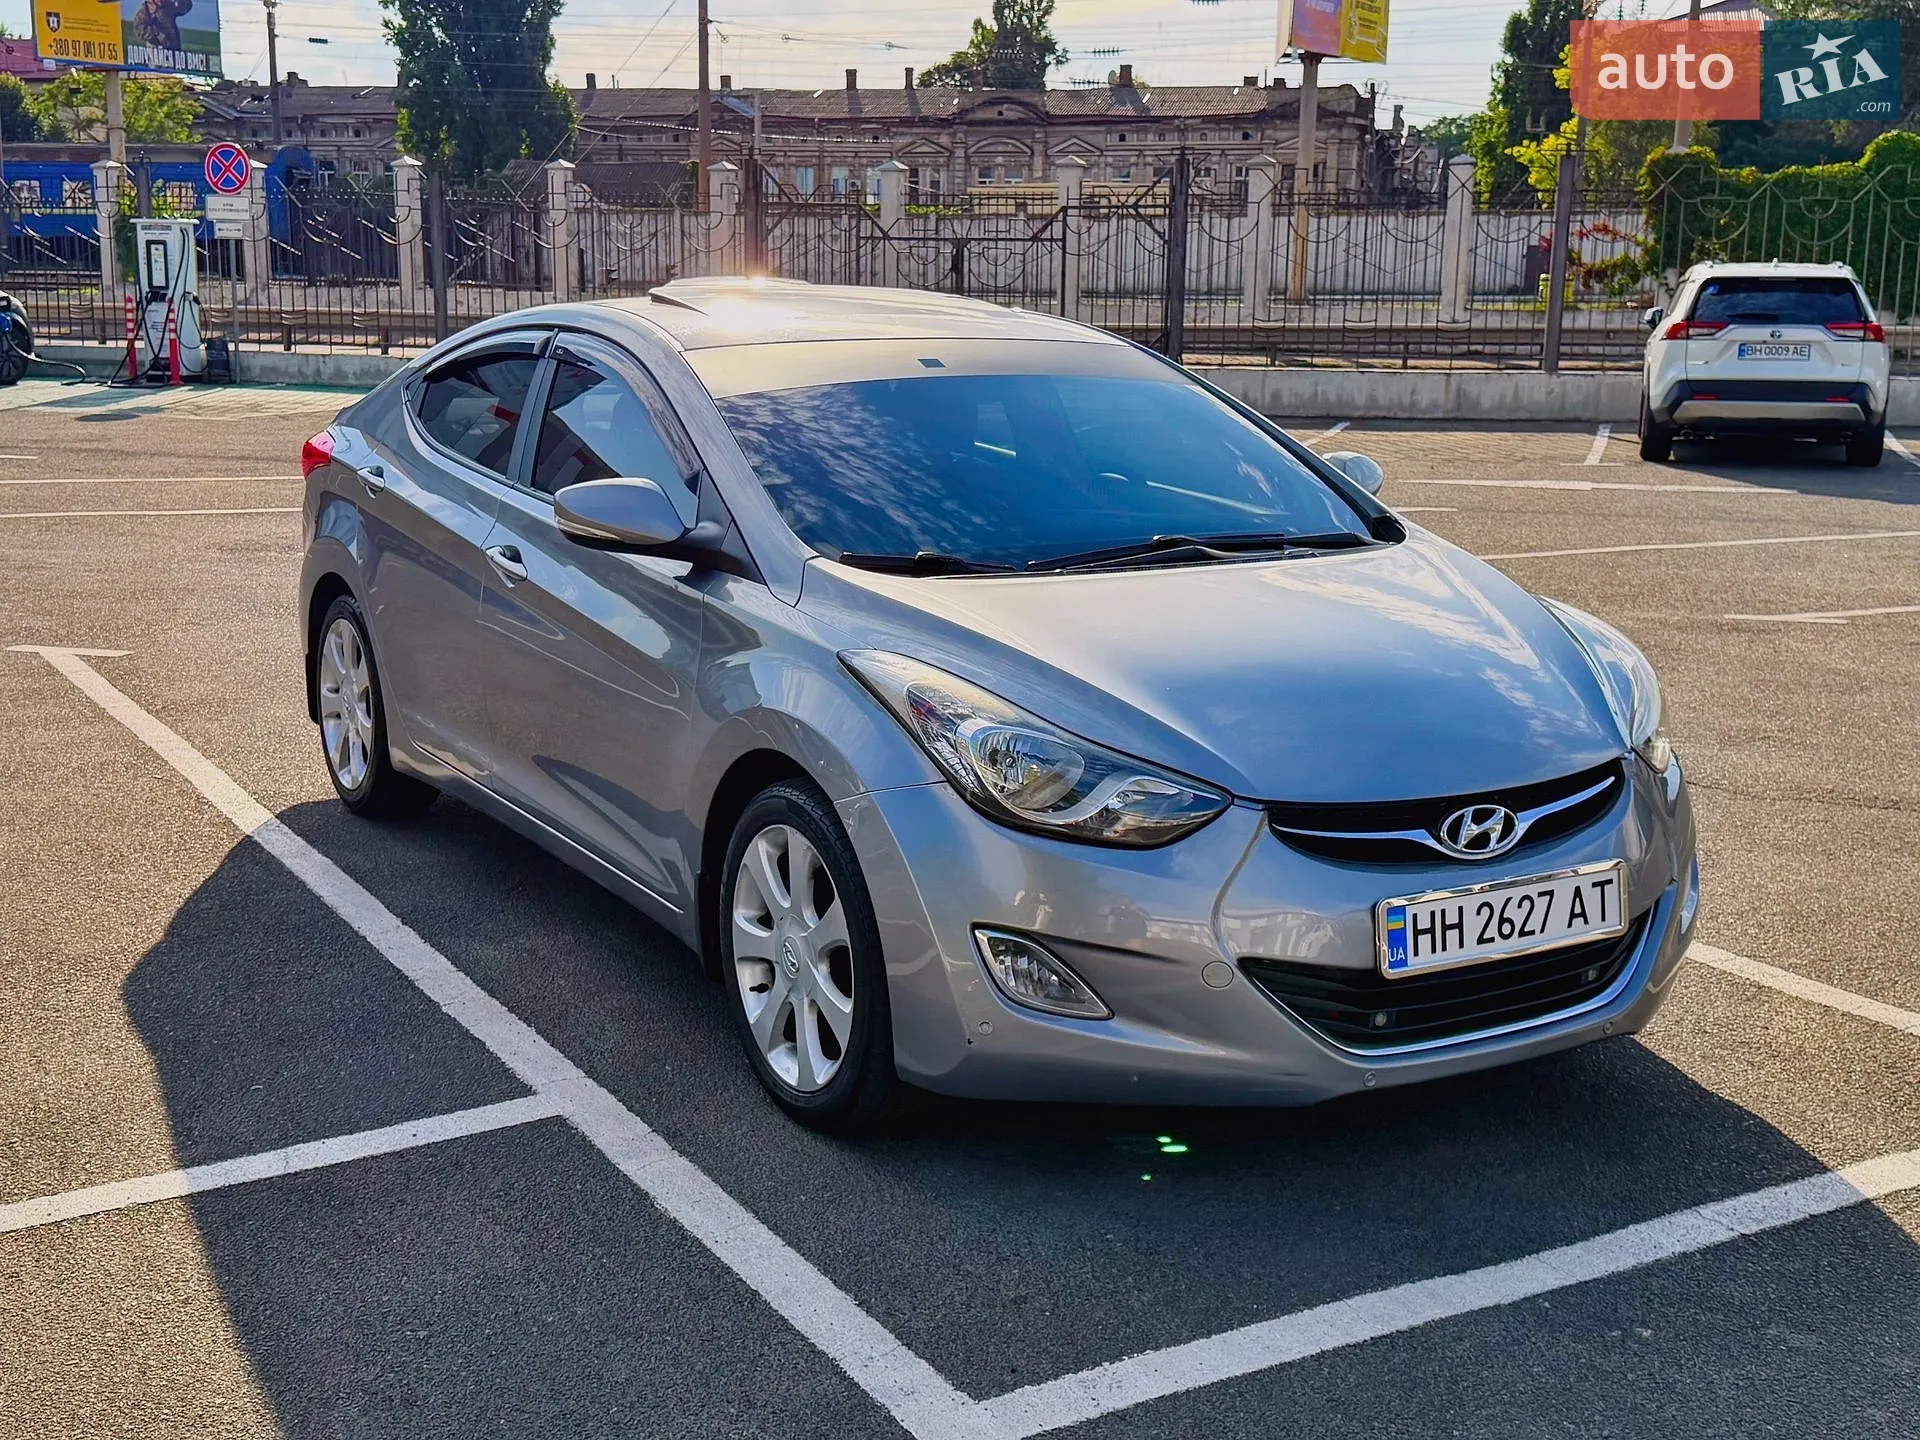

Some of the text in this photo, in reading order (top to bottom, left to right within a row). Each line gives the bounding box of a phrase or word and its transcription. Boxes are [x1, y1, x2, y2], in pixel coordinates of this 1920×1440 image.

[48, 37, 70, 57] +380
[71, 40, 81, 58] 97
[98, 42, 106, 59] 17
[107, 43, 118, 60] 55
[127, 44, 175, 67] ДОЛУЧАЙСЯ
[174, 50, 186, 70] ДО
[1746, 345, 1808, 357] BH 0009 AE
[1411, 877, 1615, 958] HH 2627 AT
[1388, 946, 1406, 962] UA
